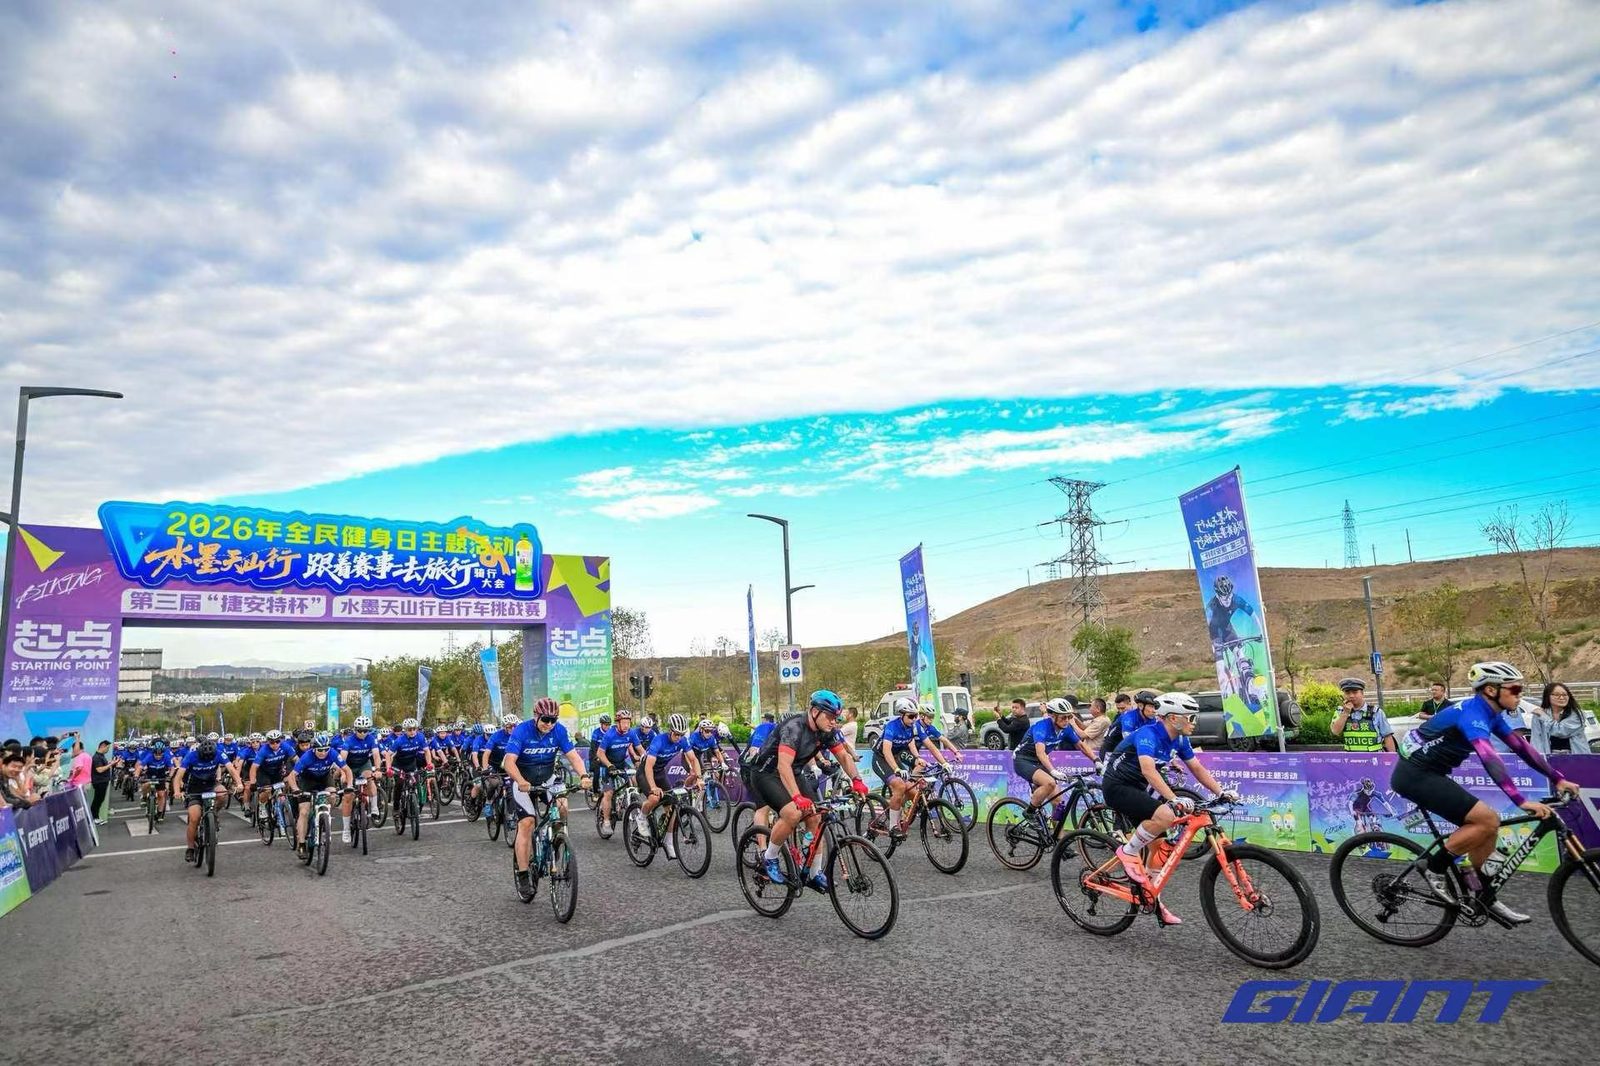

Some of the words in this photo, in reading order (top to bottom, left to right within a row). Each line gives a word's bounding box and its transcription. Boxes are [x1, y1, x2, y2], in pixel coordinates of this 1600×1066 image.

[144, 536, 302, 580] 水墨天山行
[302, 550, 480, 590] 跟着赛事去旅行
[15, 566, 110, 609] BIKING
[481, 578, 505, 589] 大会
[130, 591, 321, 615] 第三届“捷安特杯”
[341, 599, 541, 617] 水墨天山行自行车挑战赛
[12, 620, 113, 660] 起点
[551, 628, 607, 657] 起点
[11, 661, 71, 671] STARTING
[75, 661, 112, 670] POINT
[551, 658, 585, 666] STARTING
[523, 746, 559, 755] GIANT
[28, 825, 49, 849] GIANT
